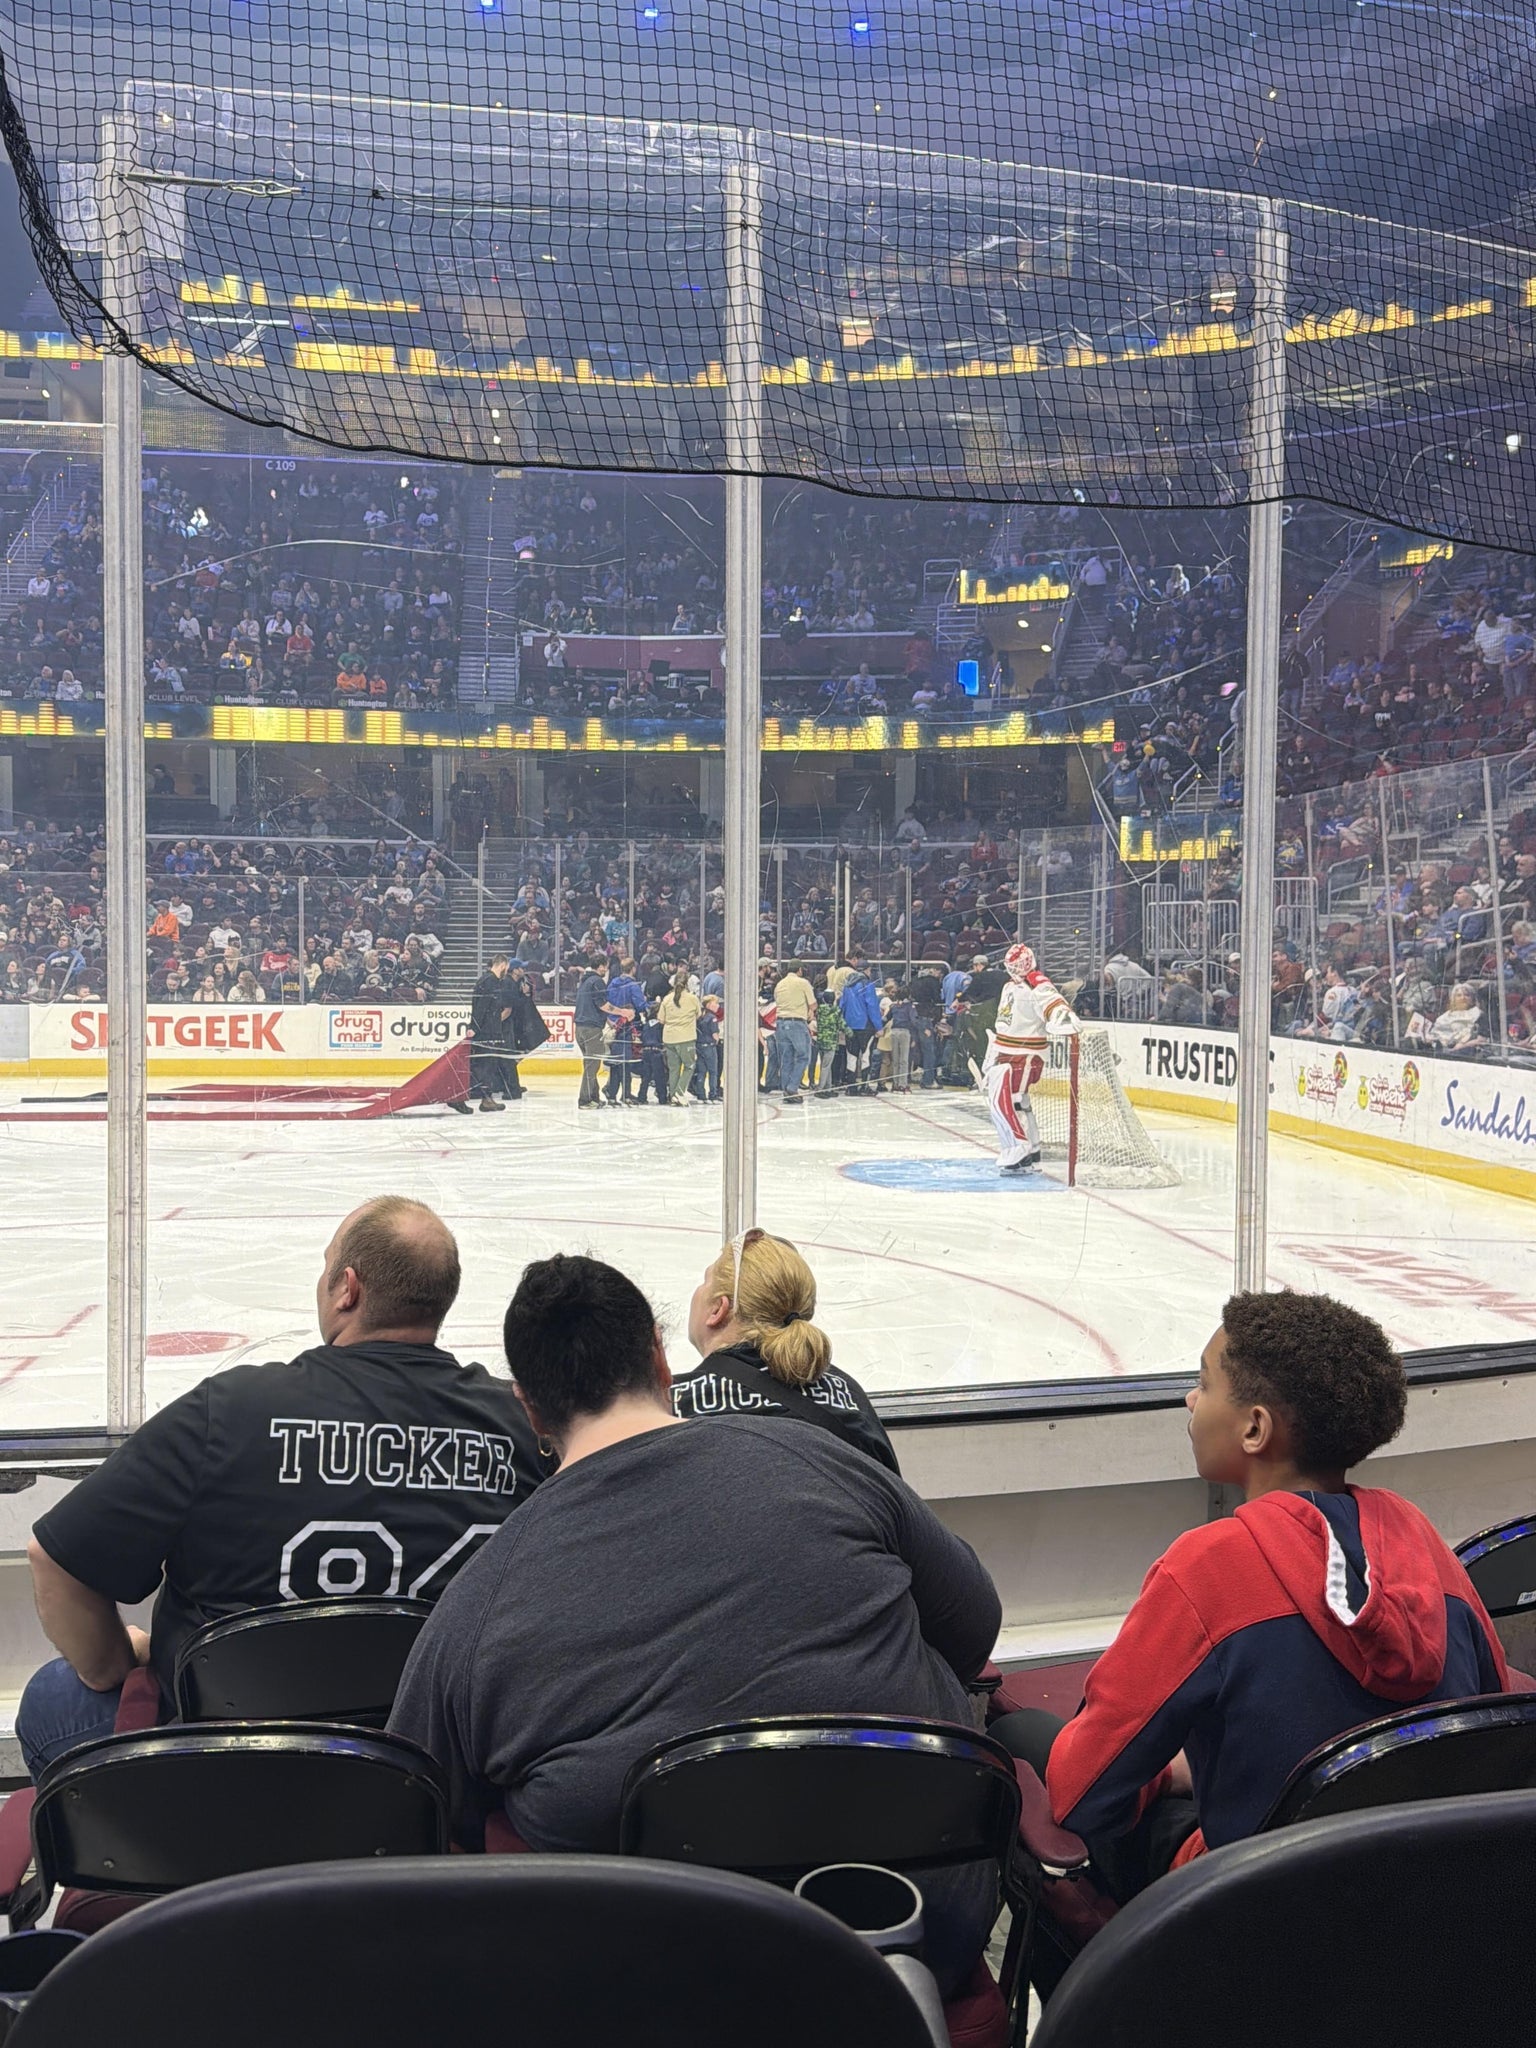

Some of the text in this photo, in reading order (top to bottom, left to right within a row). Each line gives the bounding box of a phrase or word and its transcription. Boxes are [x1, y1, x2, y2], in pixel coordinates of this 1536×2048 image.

[265, 460, 296, 471] C 109
[347, 697, 388, 709] Huntington
[333, 1010, 374, 1032] drug
[390, 1016, 450, 1043] drug
[337, 1030, 382, 1043] mart
[1142, 1037, 1238, 1087] TRUSTED
[1440, 1079, 1536, 1144] Sandals
[270, 1418, 516, 1495] TUCKER
